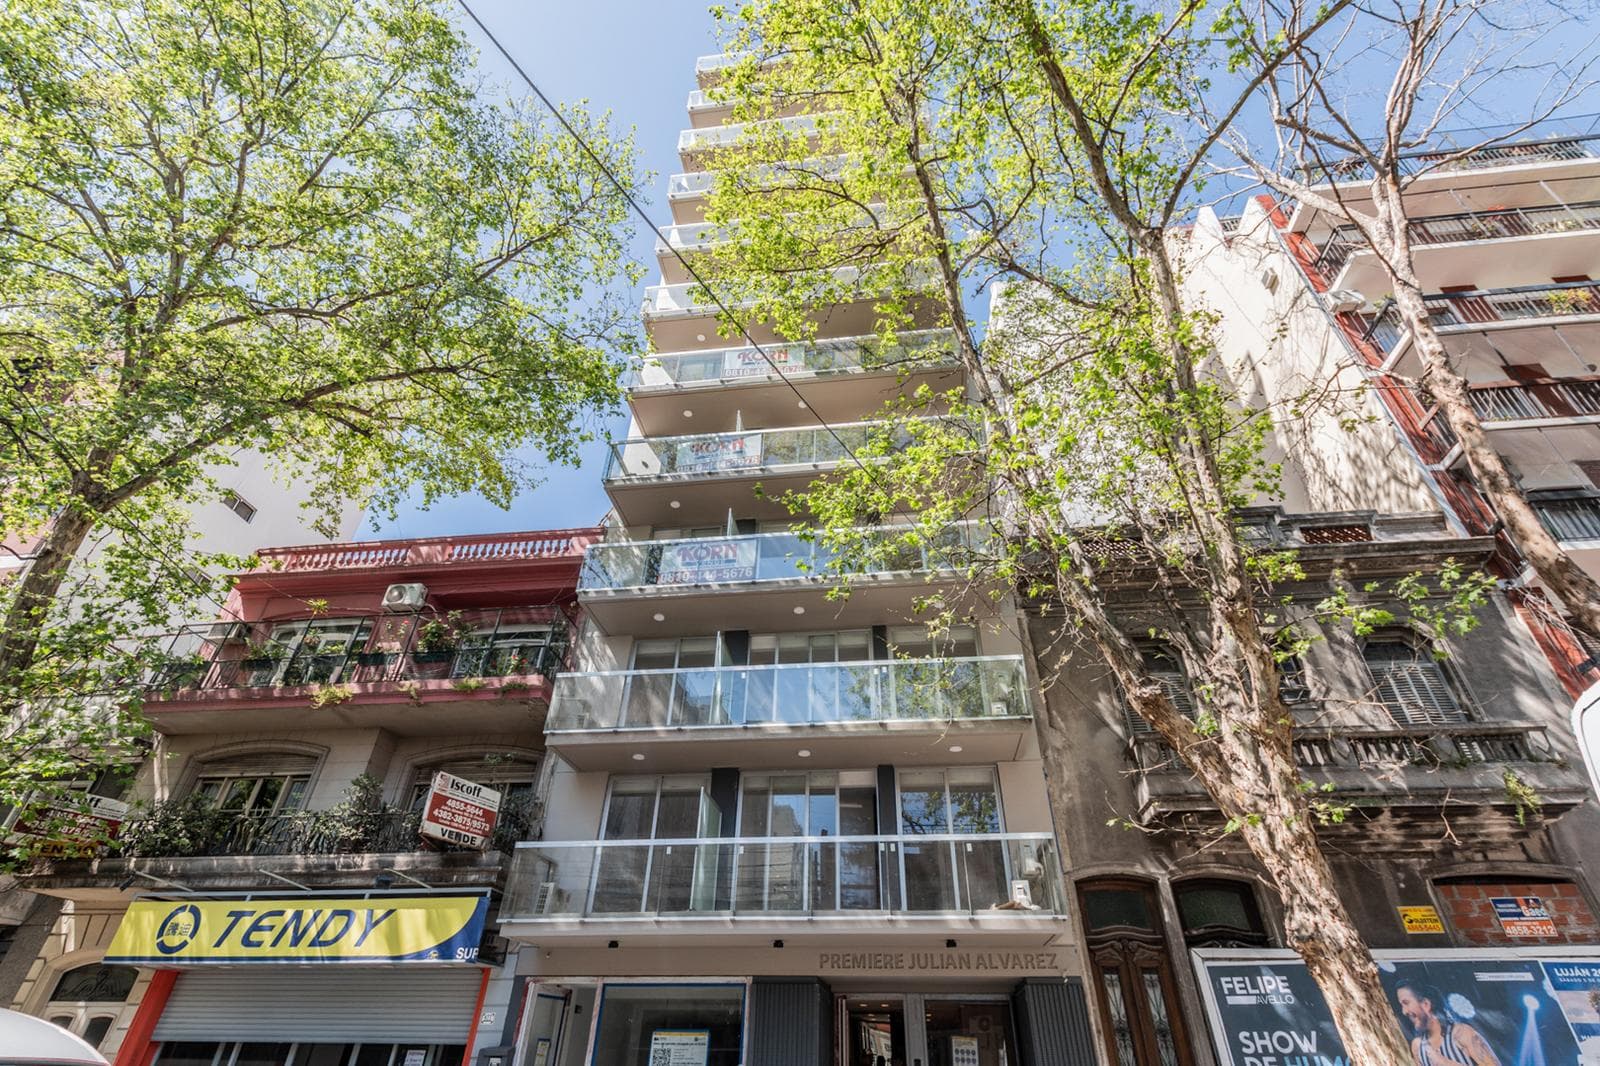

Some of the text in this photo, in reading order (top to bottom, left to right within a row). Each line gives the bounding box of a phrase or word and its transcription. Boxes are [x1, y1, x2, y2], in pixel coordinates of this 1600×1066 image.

[738, 349, 788, 361] KORN
[677, 543, 738, 561] KORN
[451, 779, 482, 797] Iscoff
[212, 908, 397, 948] TENDY
[1505, 925, 1556, 935] 4858-3212
[819, 953, 1059, 970] PREMIERE JULIAN ALVAREZ
[1553, 966, 1590, 977] LUJÁN
[1220, 976, 1292, 994] FELIPE
[1256, 995, 1295, 1005] AVELLO
[1238, 1031, 1317, 1054] SHOW
